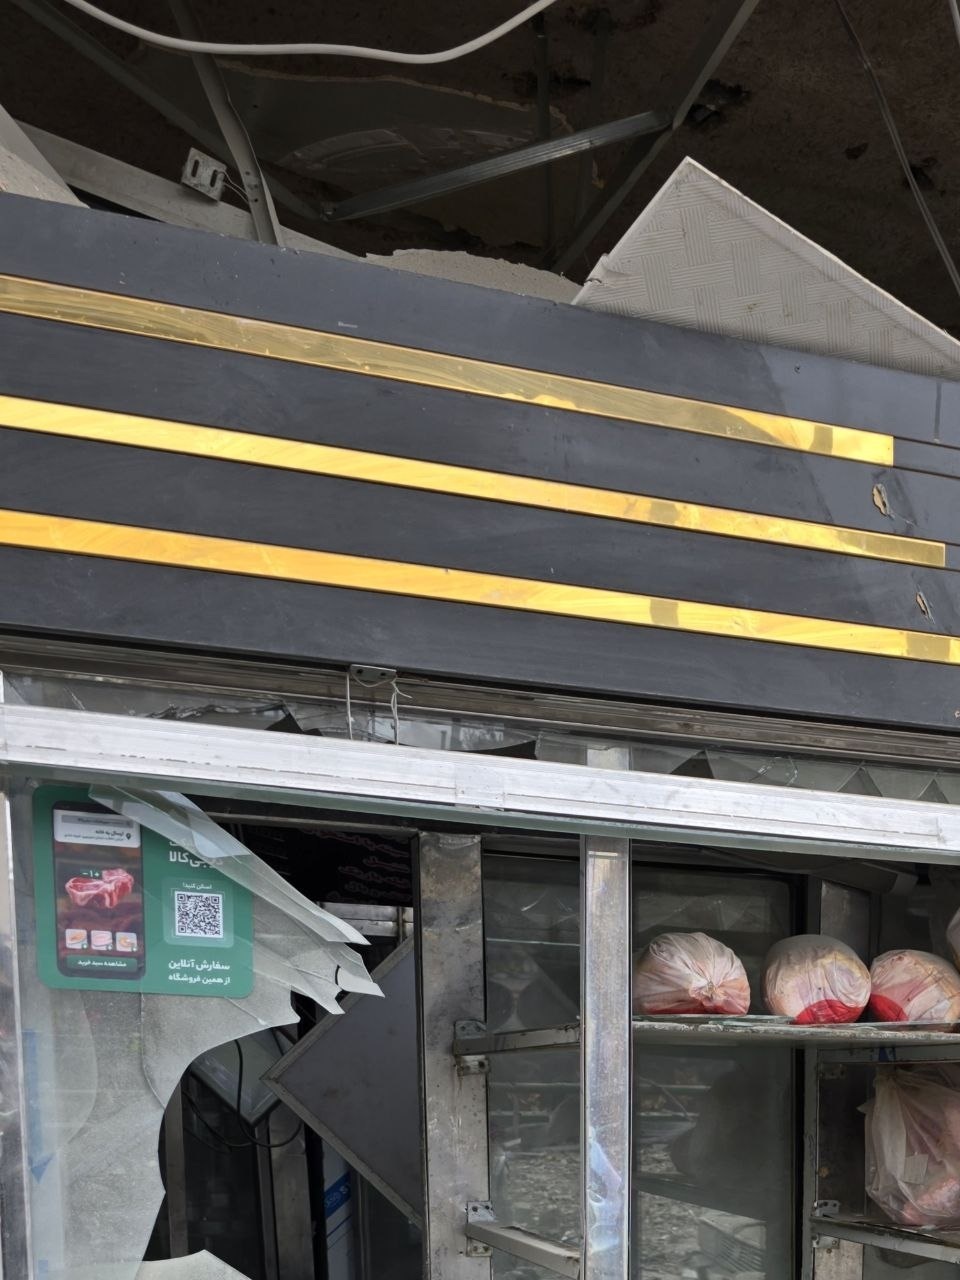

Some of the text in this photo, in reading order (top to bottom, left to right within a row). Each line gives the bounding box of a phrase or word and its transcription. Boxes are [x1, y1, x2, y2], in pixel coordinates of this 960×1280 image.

[168, 958, 231, 971] سفارش آنلاین
[168, 972, 231, 985] از همین فروشگاه
